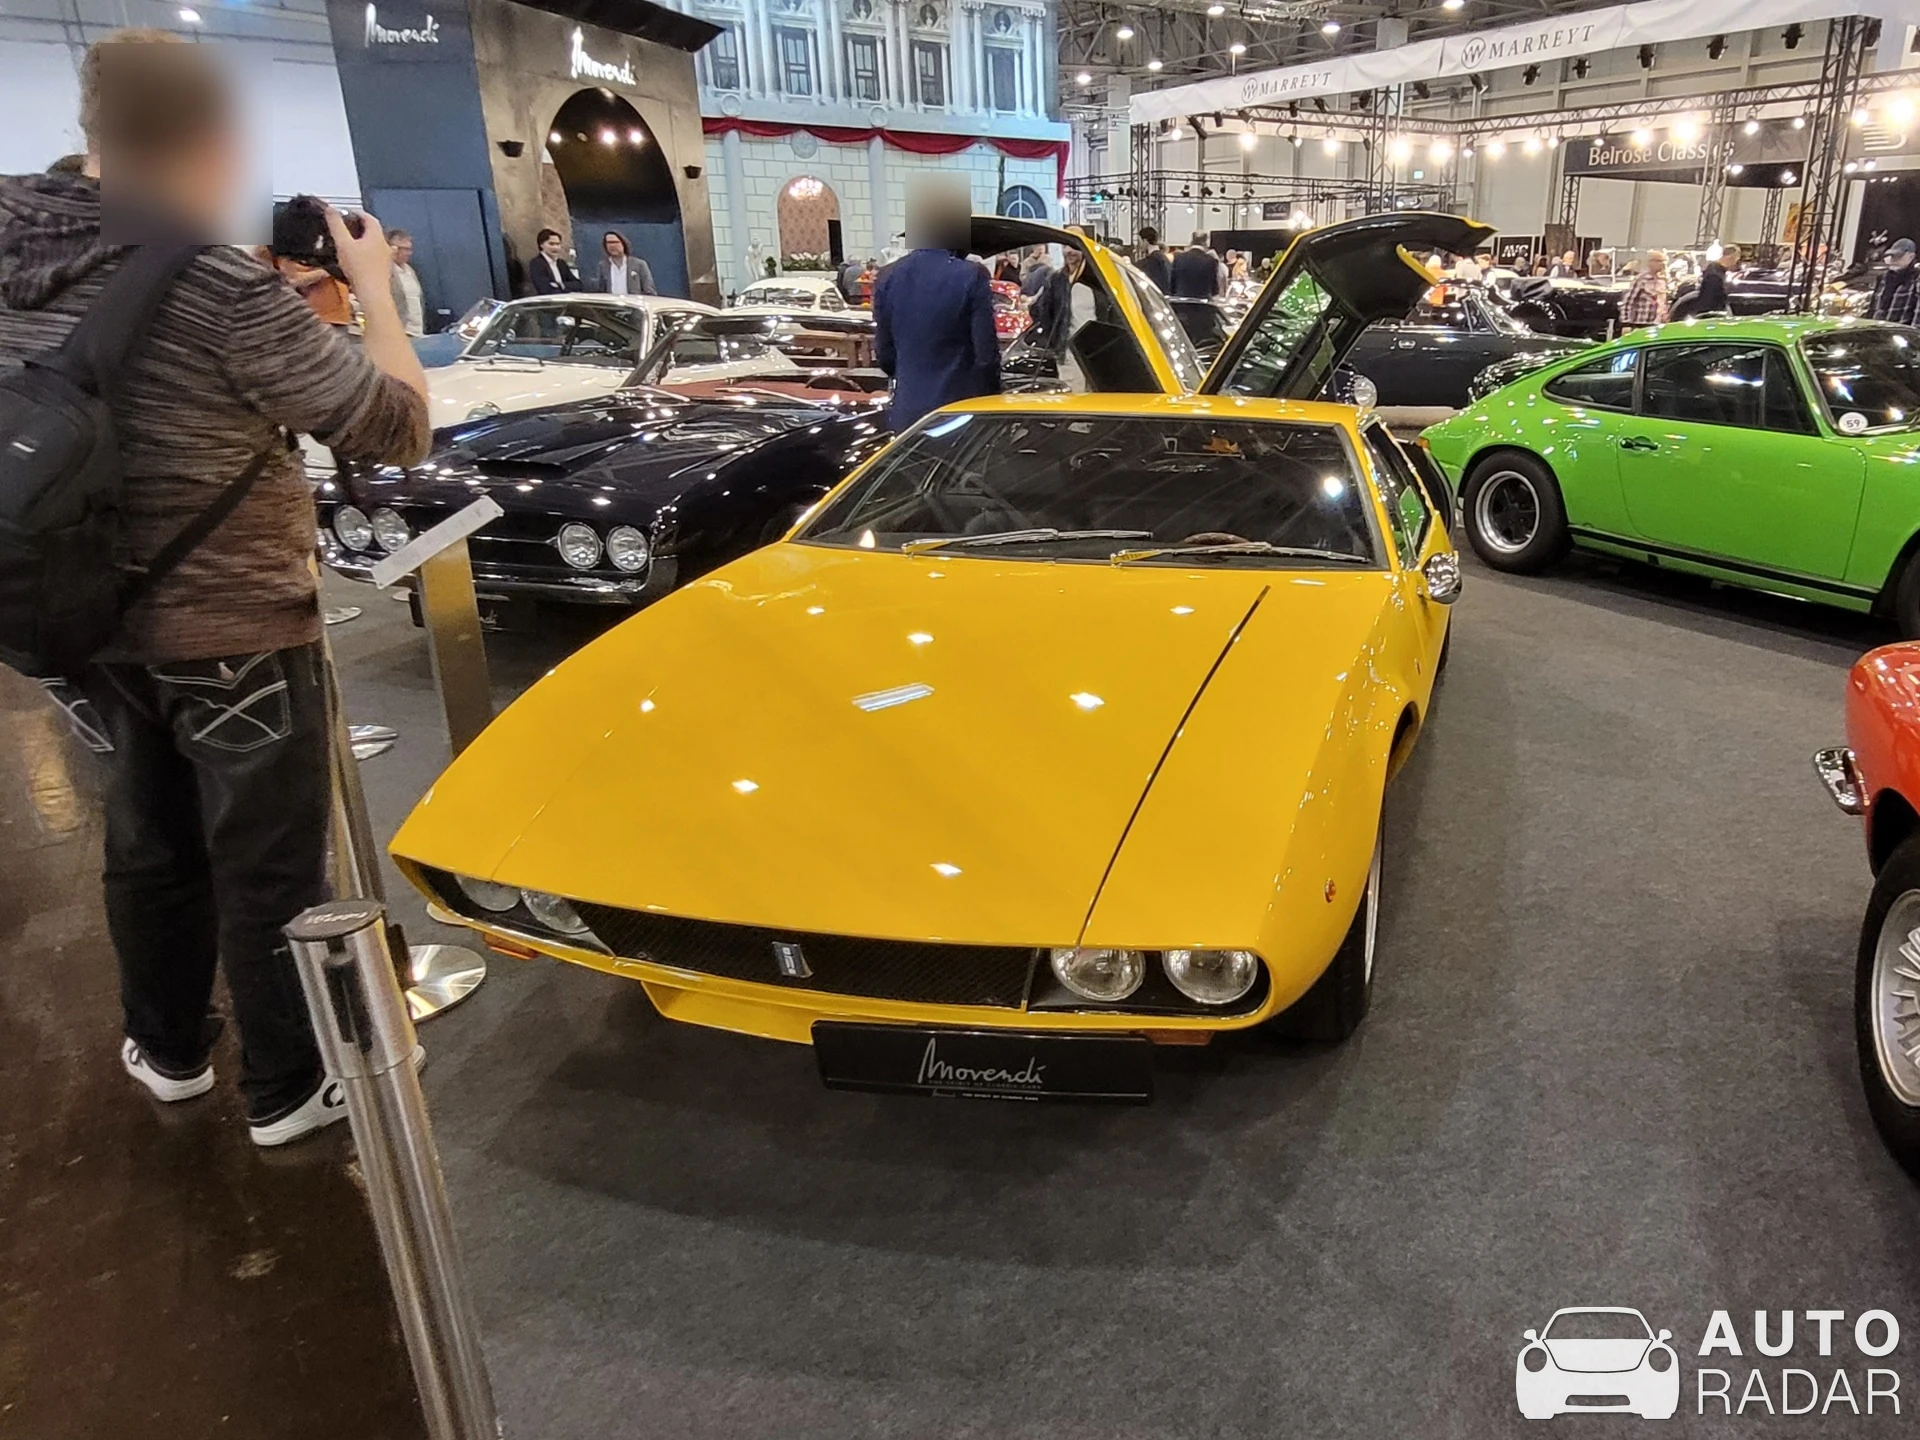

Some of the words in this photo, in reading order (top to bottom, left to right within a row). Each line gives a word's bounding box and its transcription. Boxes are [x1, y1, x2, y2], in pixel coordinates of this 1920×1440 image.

[1488, 25, 1595, 59] MARREYT
[1259, 72, 1331, 96] MARREYT
[1588, 145, 1652, 166] Belrose
[1846, 419, 1861, 428] 59
[917, 1037, 1047, 1084] Movendi
